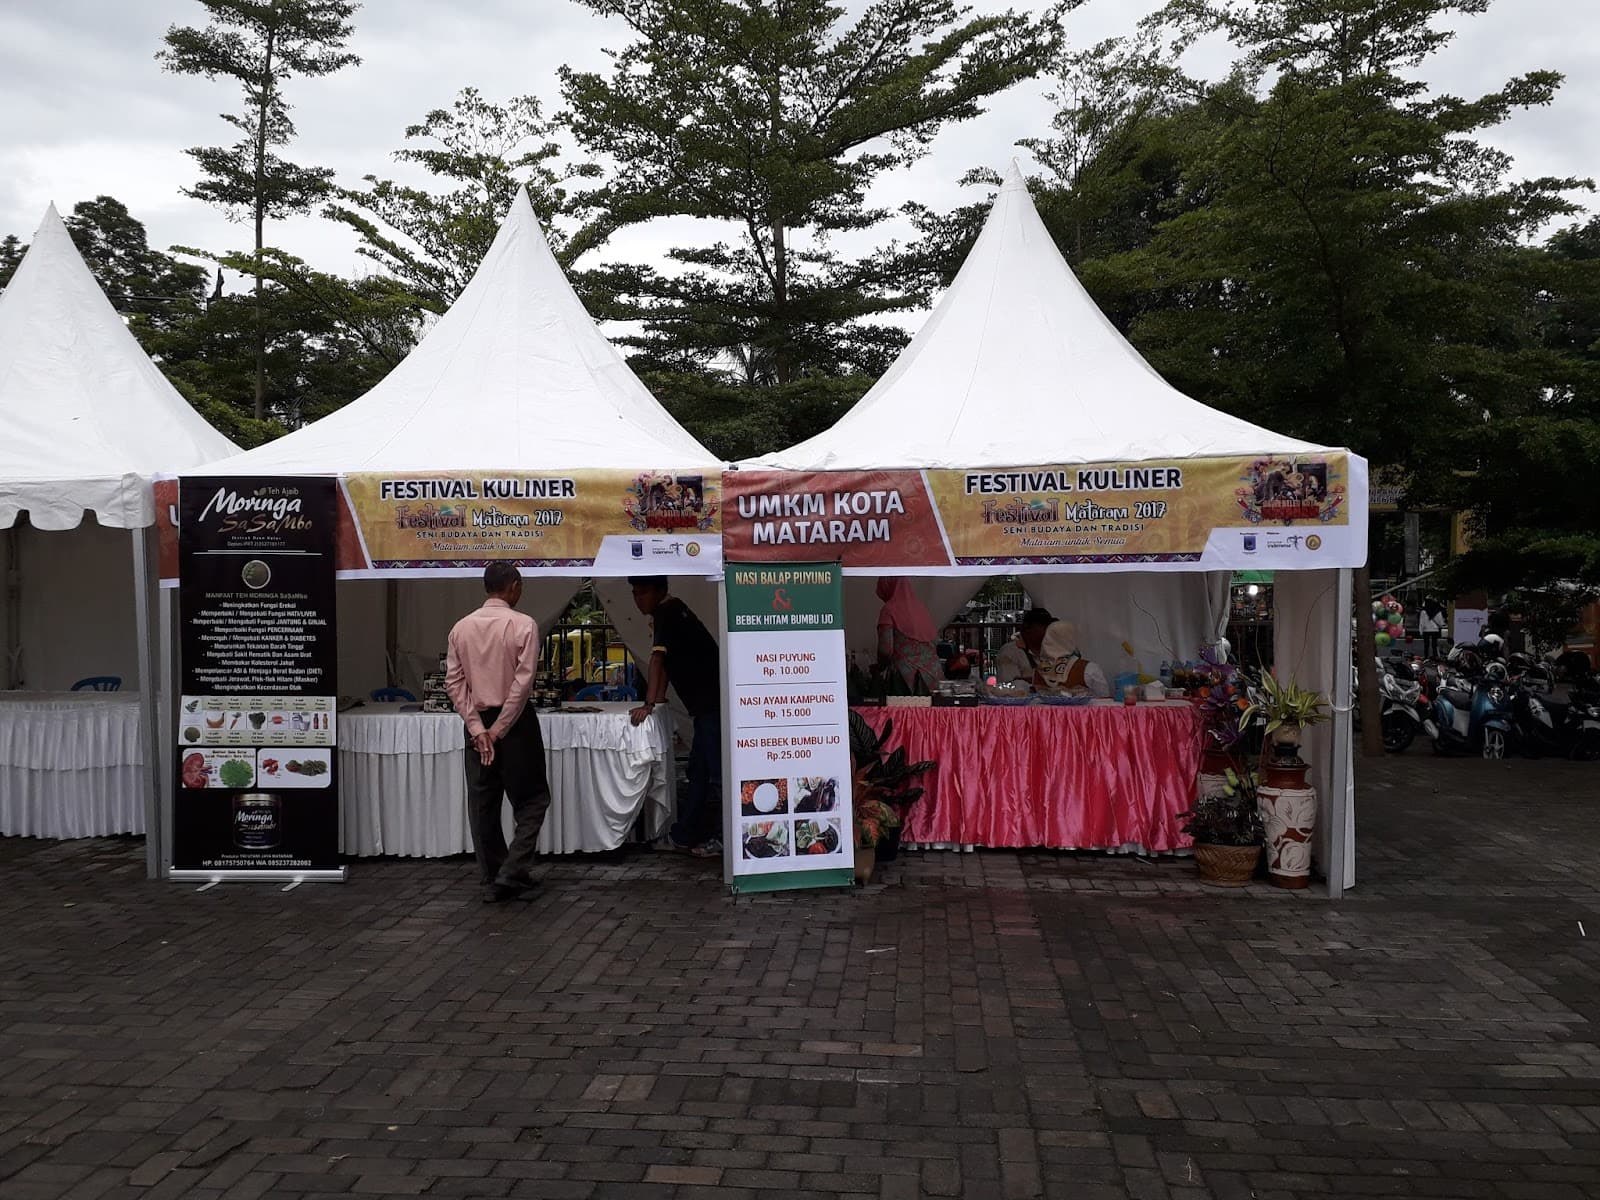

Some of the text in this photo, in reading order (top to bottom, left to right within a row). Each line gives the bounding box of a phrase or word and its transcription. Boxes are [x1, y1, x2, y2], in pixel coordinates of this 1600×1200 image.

[966, 468, 1182, 494] FESTIVAL KULINER
[268, 487, 299, 496] Teh Ajaib
[380, 479, 576, 499] FESTIVAL KULINER
[198, 487, 302, 522] Moringa
[738, 490, 905, 518] UMKM KOTA
[395, 503, 564, 530] Festival Mataram 2017
[982, 497, 1167, 525] Festival Mataram 2017
[416, 530, 544, 538] SENI BUDAYA DAN TRADISI
[753, 519, 891, 545] MATARAM
[1030, 525, 1072, 534] BUDAYA
[1101, 523, 1144, 532] TRADISI
[472, 541, 496, 551] untuk
[497, 541, 528, 551] Semua
[1064, 537, 1091, 546] untuk
[1093, 535, 1127, 545] Semua
[735, 571, 832, 585] NASI BALAP PUYUNG
[772, 588, 793, 611] &
[735, 614, 834, 626] BEBEK HITAM BUMBU IJO
[756, 653, 816, 662] NASI PUYUNG
[763, 666, 810, 676] Rp. 10.000
[740, 695, 834, 706] NASI AYAM KAMPUNG
[764, 708, 811, 720] Rp. 15.000
[737, 736, 840, 748] NASI BEBEK BUMBU IJO
[767, 750, 812, 762] Rp.25.000
